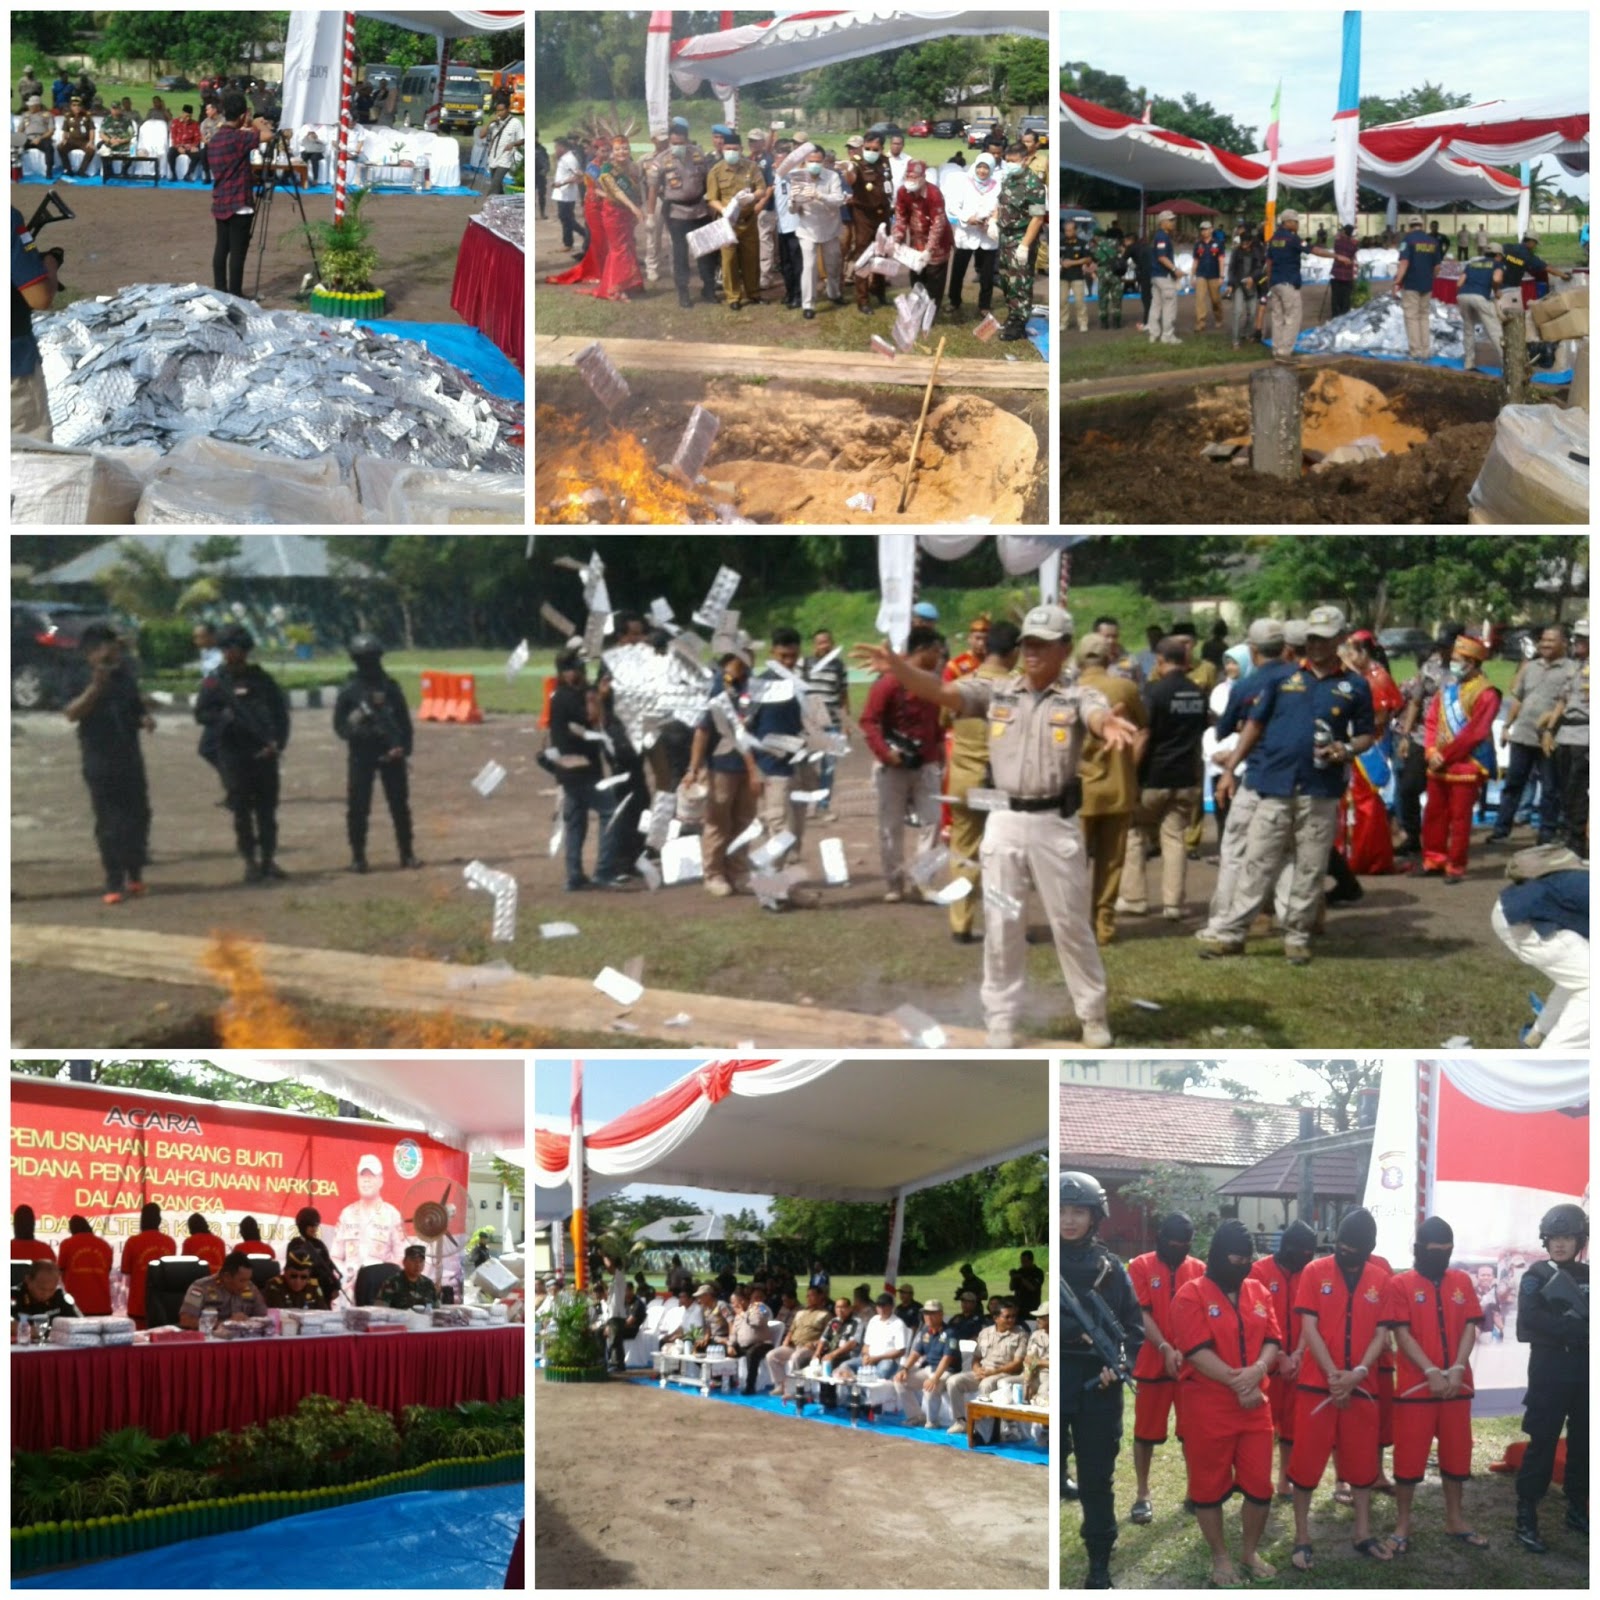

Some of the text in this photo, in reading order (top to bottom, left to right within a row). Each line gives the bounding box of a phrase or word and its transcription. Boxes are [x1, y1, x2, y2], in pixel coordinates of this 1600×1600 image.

[104, 1106, 202, 1134] ACARA
[11, 1127, 283, 1168] PEMUSNAHAN BARANG BUKTI
[11, 1156, 339, 1196] PIDANA PENYALAHGUNAAN NARKOBA
[75, 1188, 225, 1213] DALAM RANGKA
[227, 1222, 284, 1241] TUN
